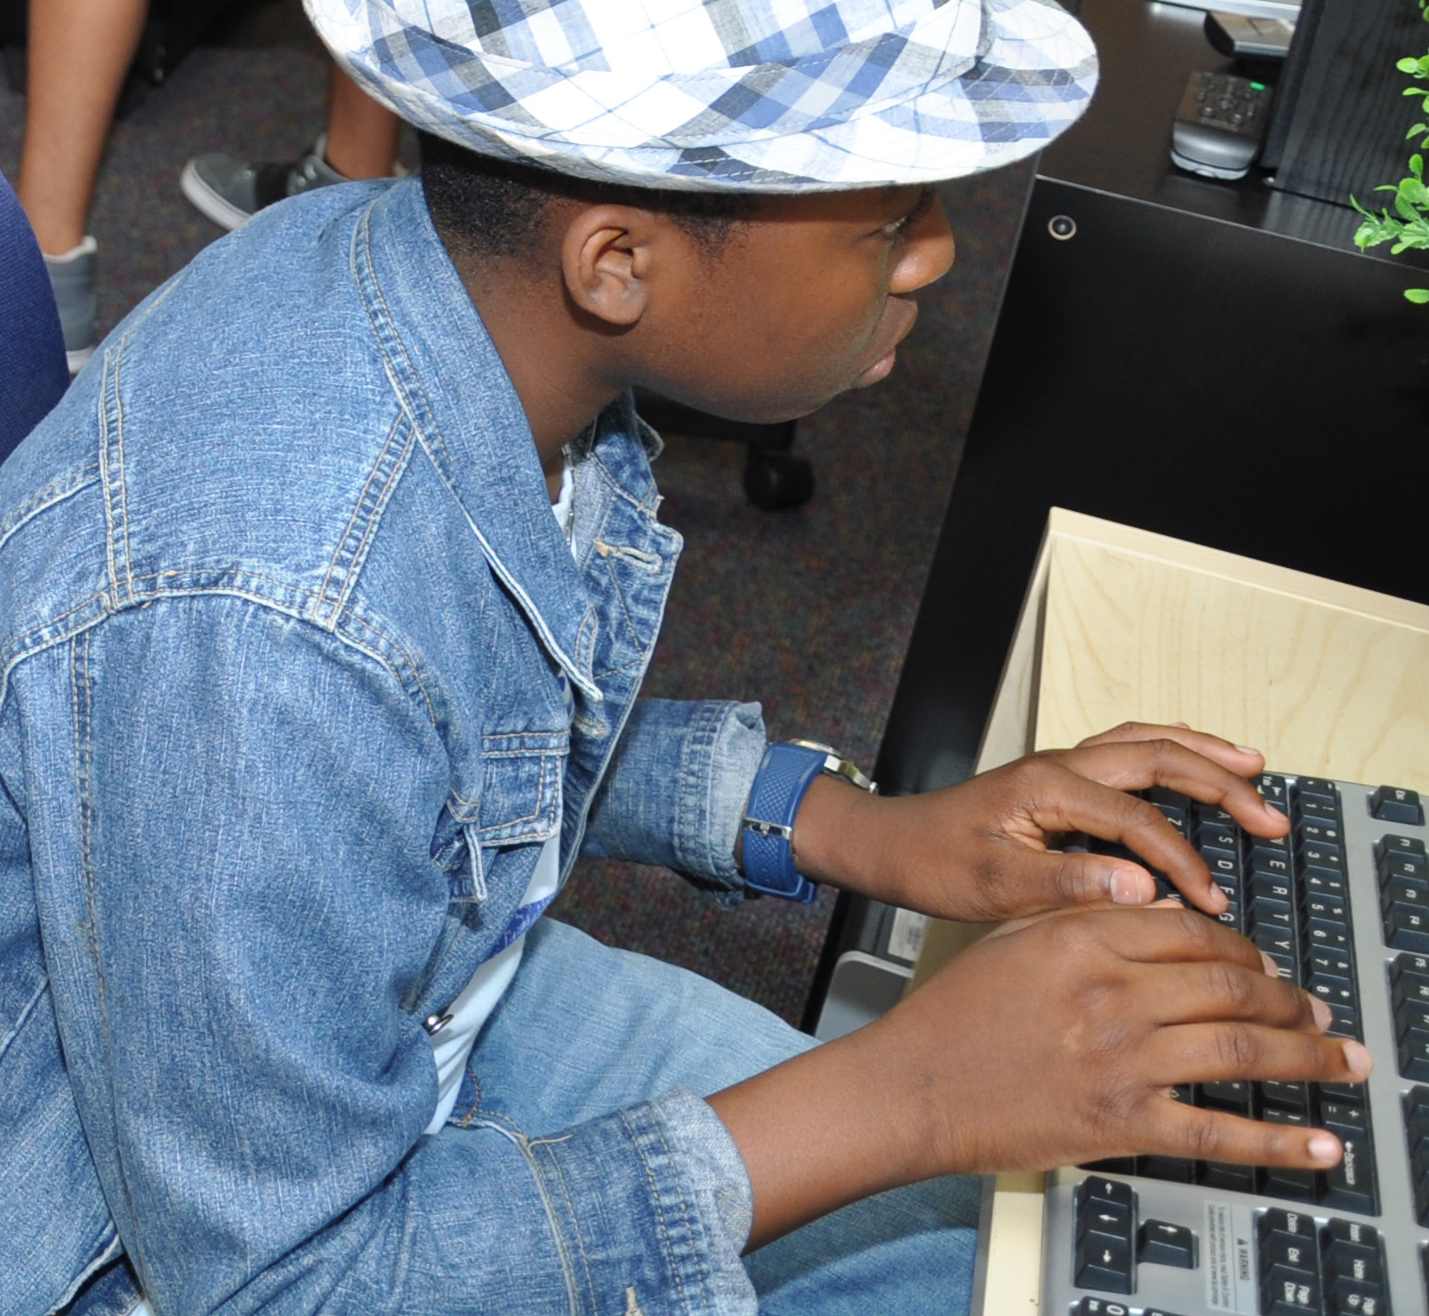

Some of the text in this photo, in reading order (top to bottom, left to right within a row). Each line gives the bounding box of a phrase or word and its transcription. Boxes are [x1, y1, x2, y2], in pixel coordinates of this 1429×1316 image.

[1217, 811, 1231, 819] A
[1167, 817, 1182, 826] Z
[1218, 836, 1234, 844] S
[1400, 838, 1410, 847] F1
[1217, 860, 1234, 869] D
[1269, 860, 1286, 869] E
[1404, 864, 1415, 872] F2
[1219, 886, 1235, 895] F
[1272, 886, 1288, 895] R
[1405, 889, 1416, 898] F3
[1219, 912, 1235, 921] G
[1272, 913, 1289, 921] T
[1409, 915, 1420, 925] F4
[1313, 929, 1327, 937] 6
[1274, 940, 1291, 949] Y
[1415, 957, 1427, 967] F5
[1277, 967, 1292, 978] U
[1316, 985, 1330, 993] 8
[1287, 1213, 1298, 1233] Delete
[1288, 1247, 1300, 1262] End
[1239, 1248, 1250, 1281] WARNING
[1353, 1259, 1365, 1280] Home
[1284, 1282, 1296, 1302] Down
[1297, 1285, 1310, 1304] Page
[1347, 1294, 1360, 1306] Up
[1106, 1305, 1125, 1316] 0
[1362, 1297, 1375, 1316] Page
